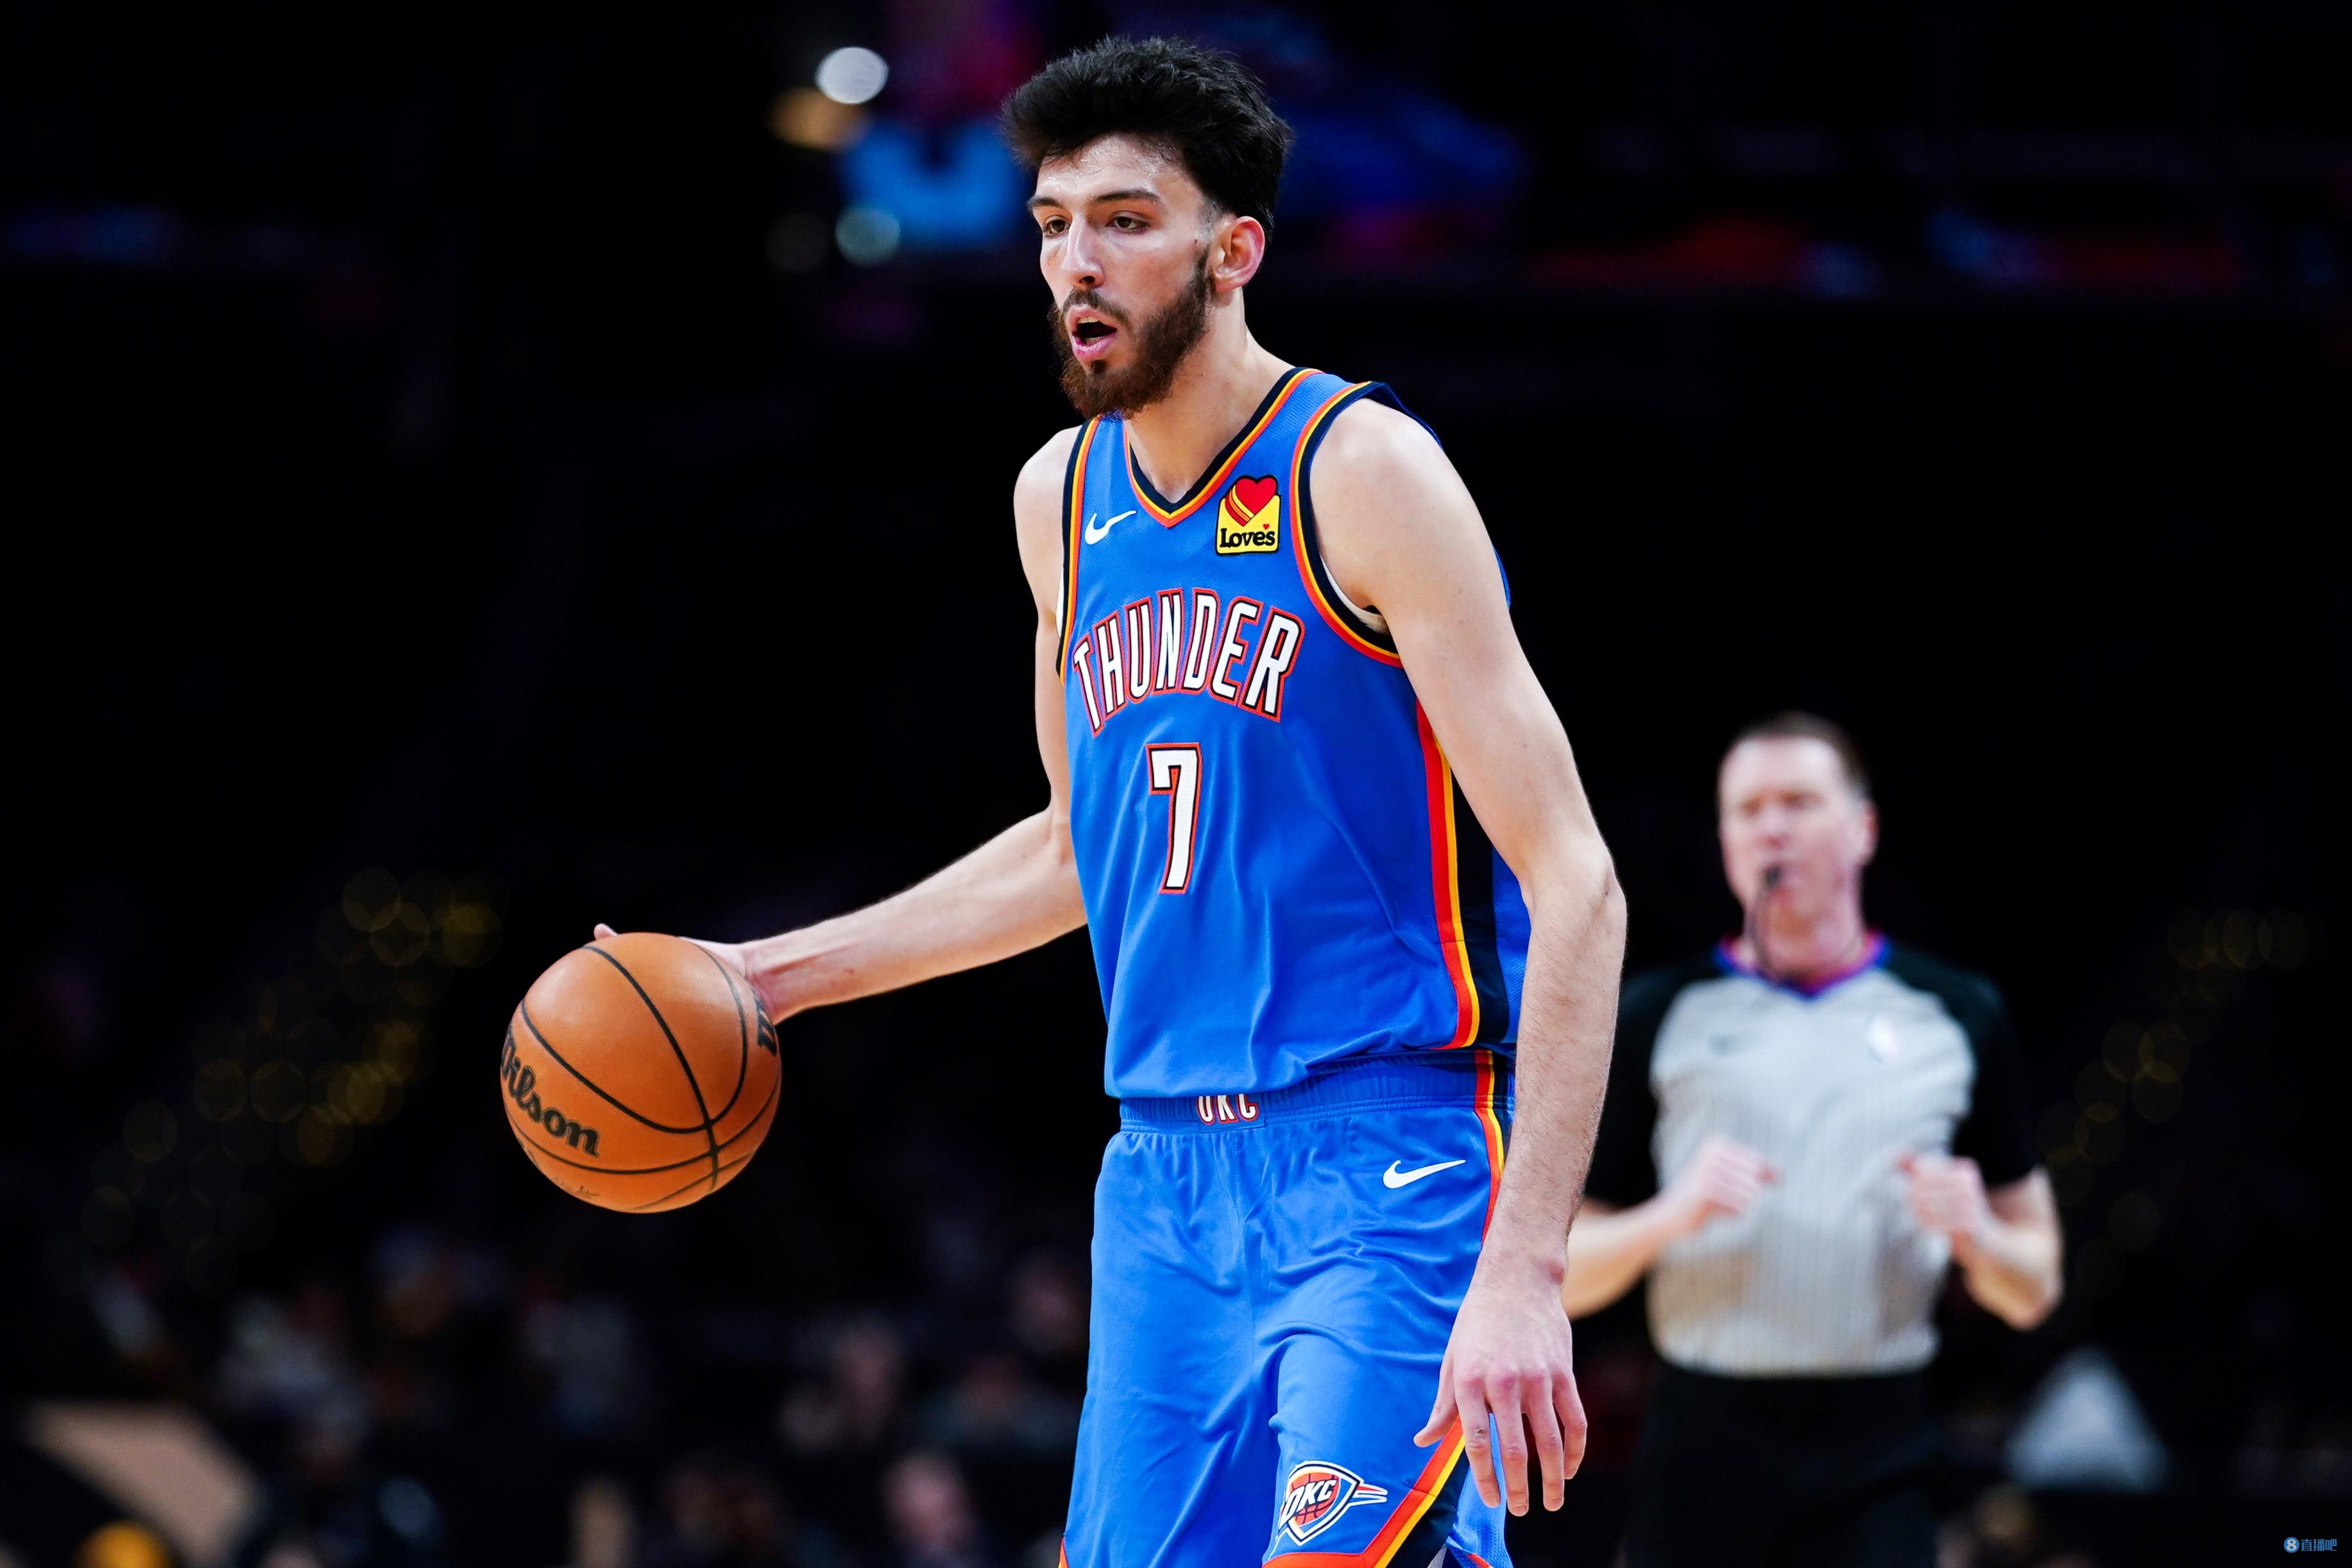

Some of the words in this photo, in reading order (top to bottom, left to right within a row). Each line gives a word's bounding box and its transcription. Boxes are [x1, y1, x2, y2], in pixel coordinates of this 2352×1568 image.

[1073, 587, 1306, 738] THUNDER
[1146, 742, 1202, 894] 7
[1278, 1478, 1338, 1530] OKC
